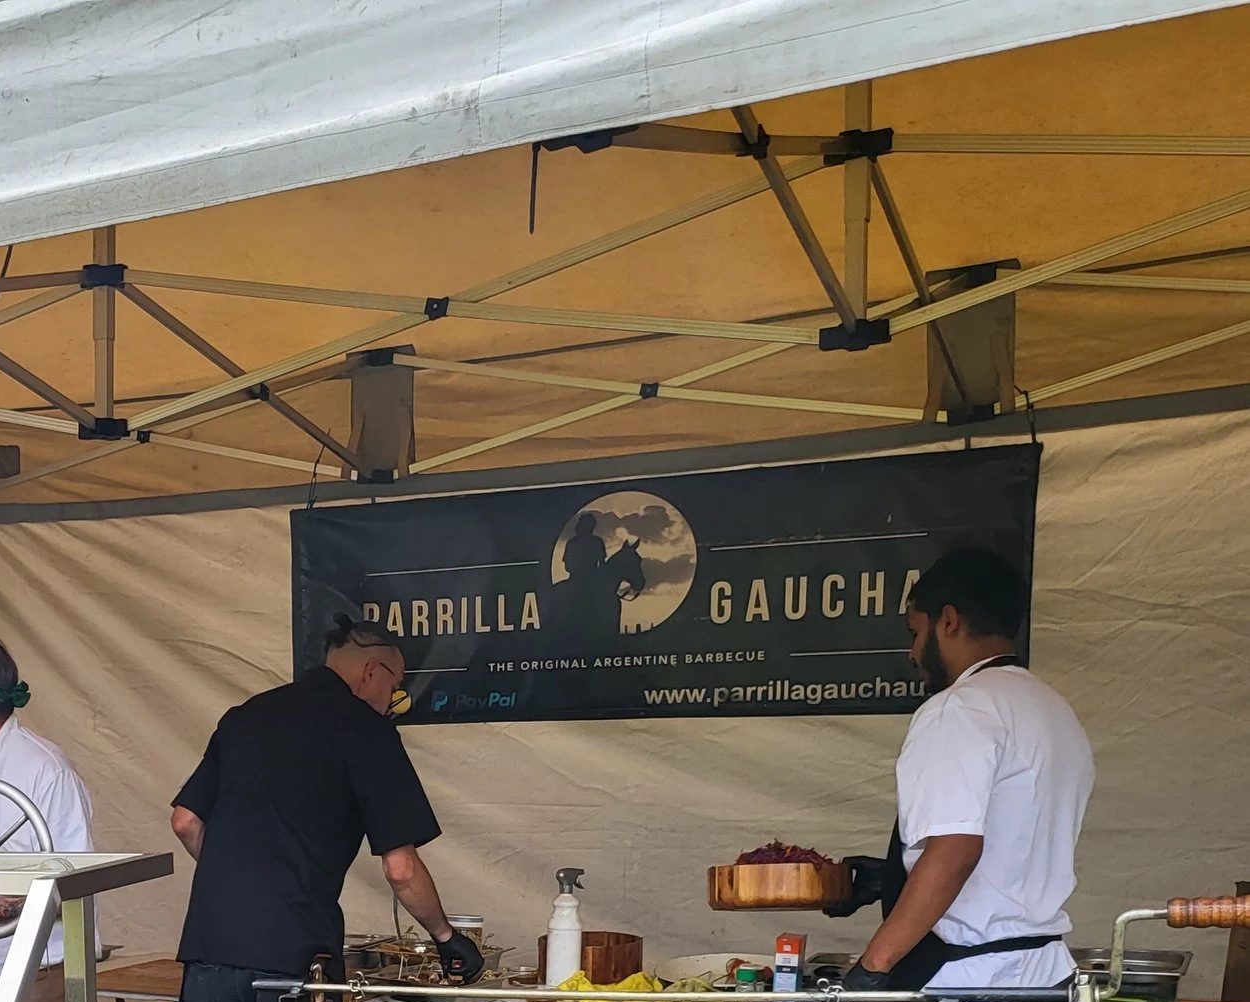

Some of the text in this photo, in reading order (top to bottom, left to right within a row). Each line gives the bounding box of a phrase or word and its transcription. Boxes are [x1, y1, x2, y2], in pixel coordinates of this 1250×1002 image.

[488, 650, 767, 673] THE ORIGINAL ARGENTINE BARBECUE
[456, 691, 518, 709] PayPal
